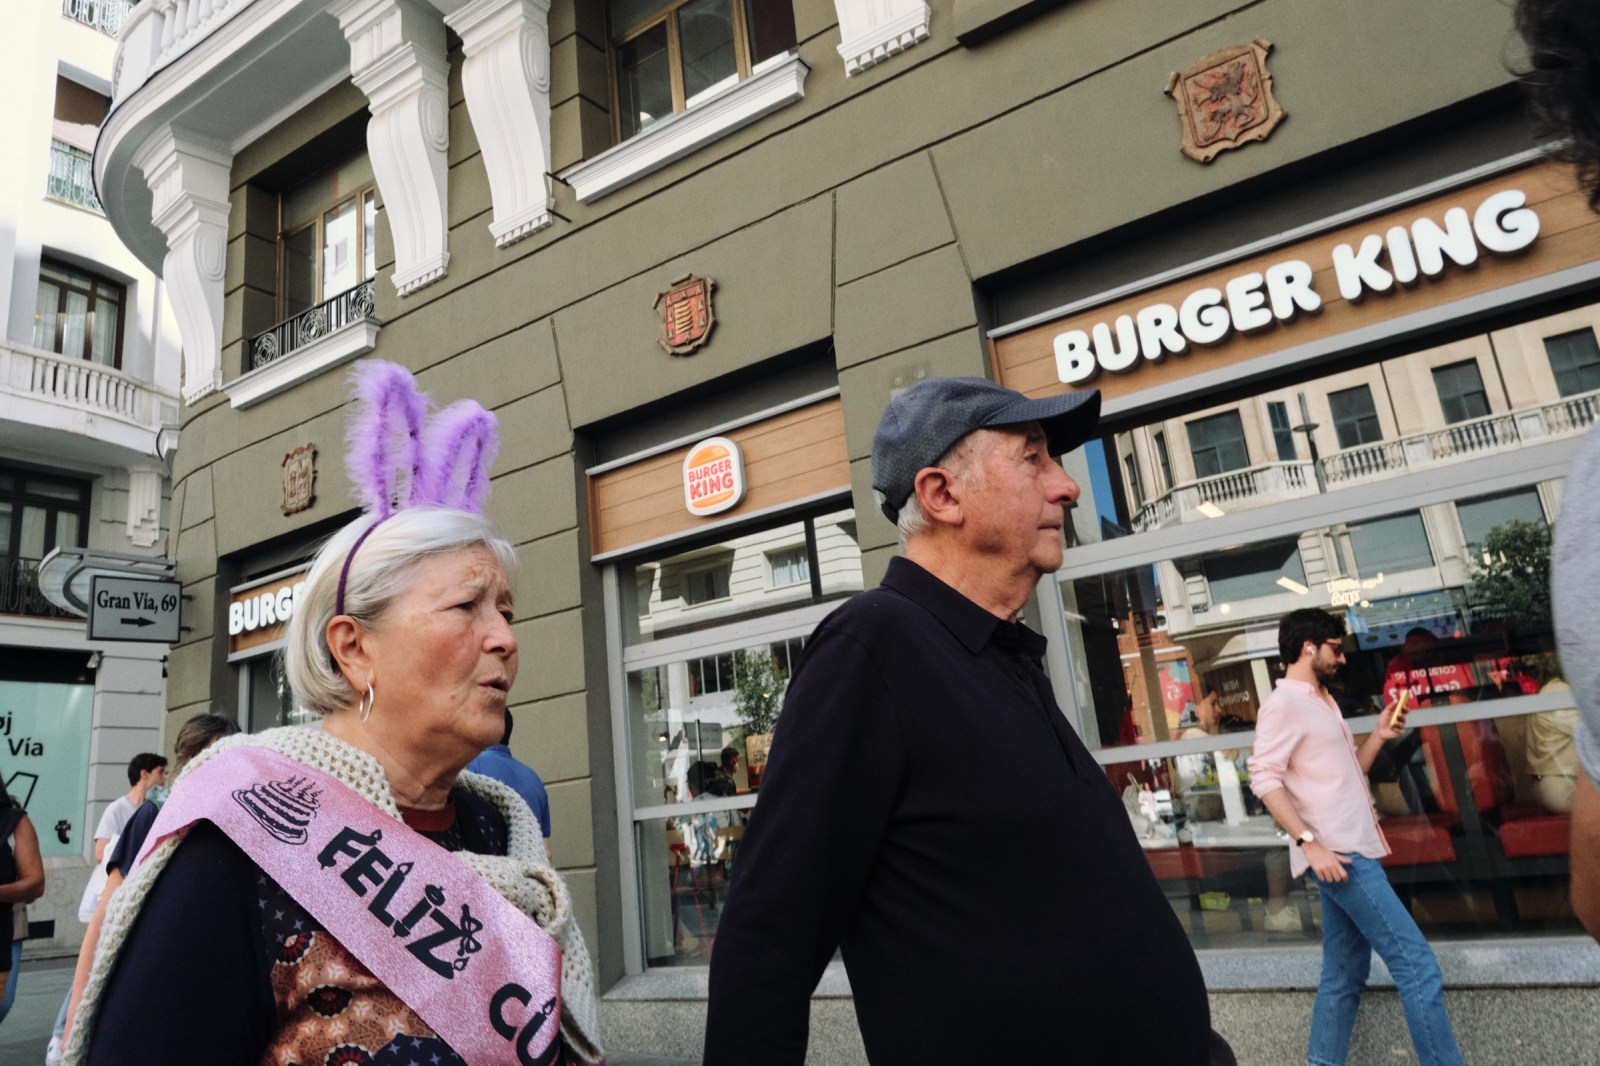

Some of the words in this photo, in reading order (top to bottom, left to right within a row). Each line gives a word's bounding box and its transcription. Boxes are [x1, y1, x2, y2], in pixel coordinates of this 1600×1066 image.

[1053, 260, 1321, 384] BURGER
[1332, 189, 1540, 300] KING
[688, 459, 732, 483] BURGER
[690, 472, 734, 500] KING
[97, 590, 131, 609] Gran
[133, 592, 159, 614] Vía,
[161, 594, 177, 613] 69
[8, 737, 44, 756] Vía
[317, 826, 483, 980] FELIZ
